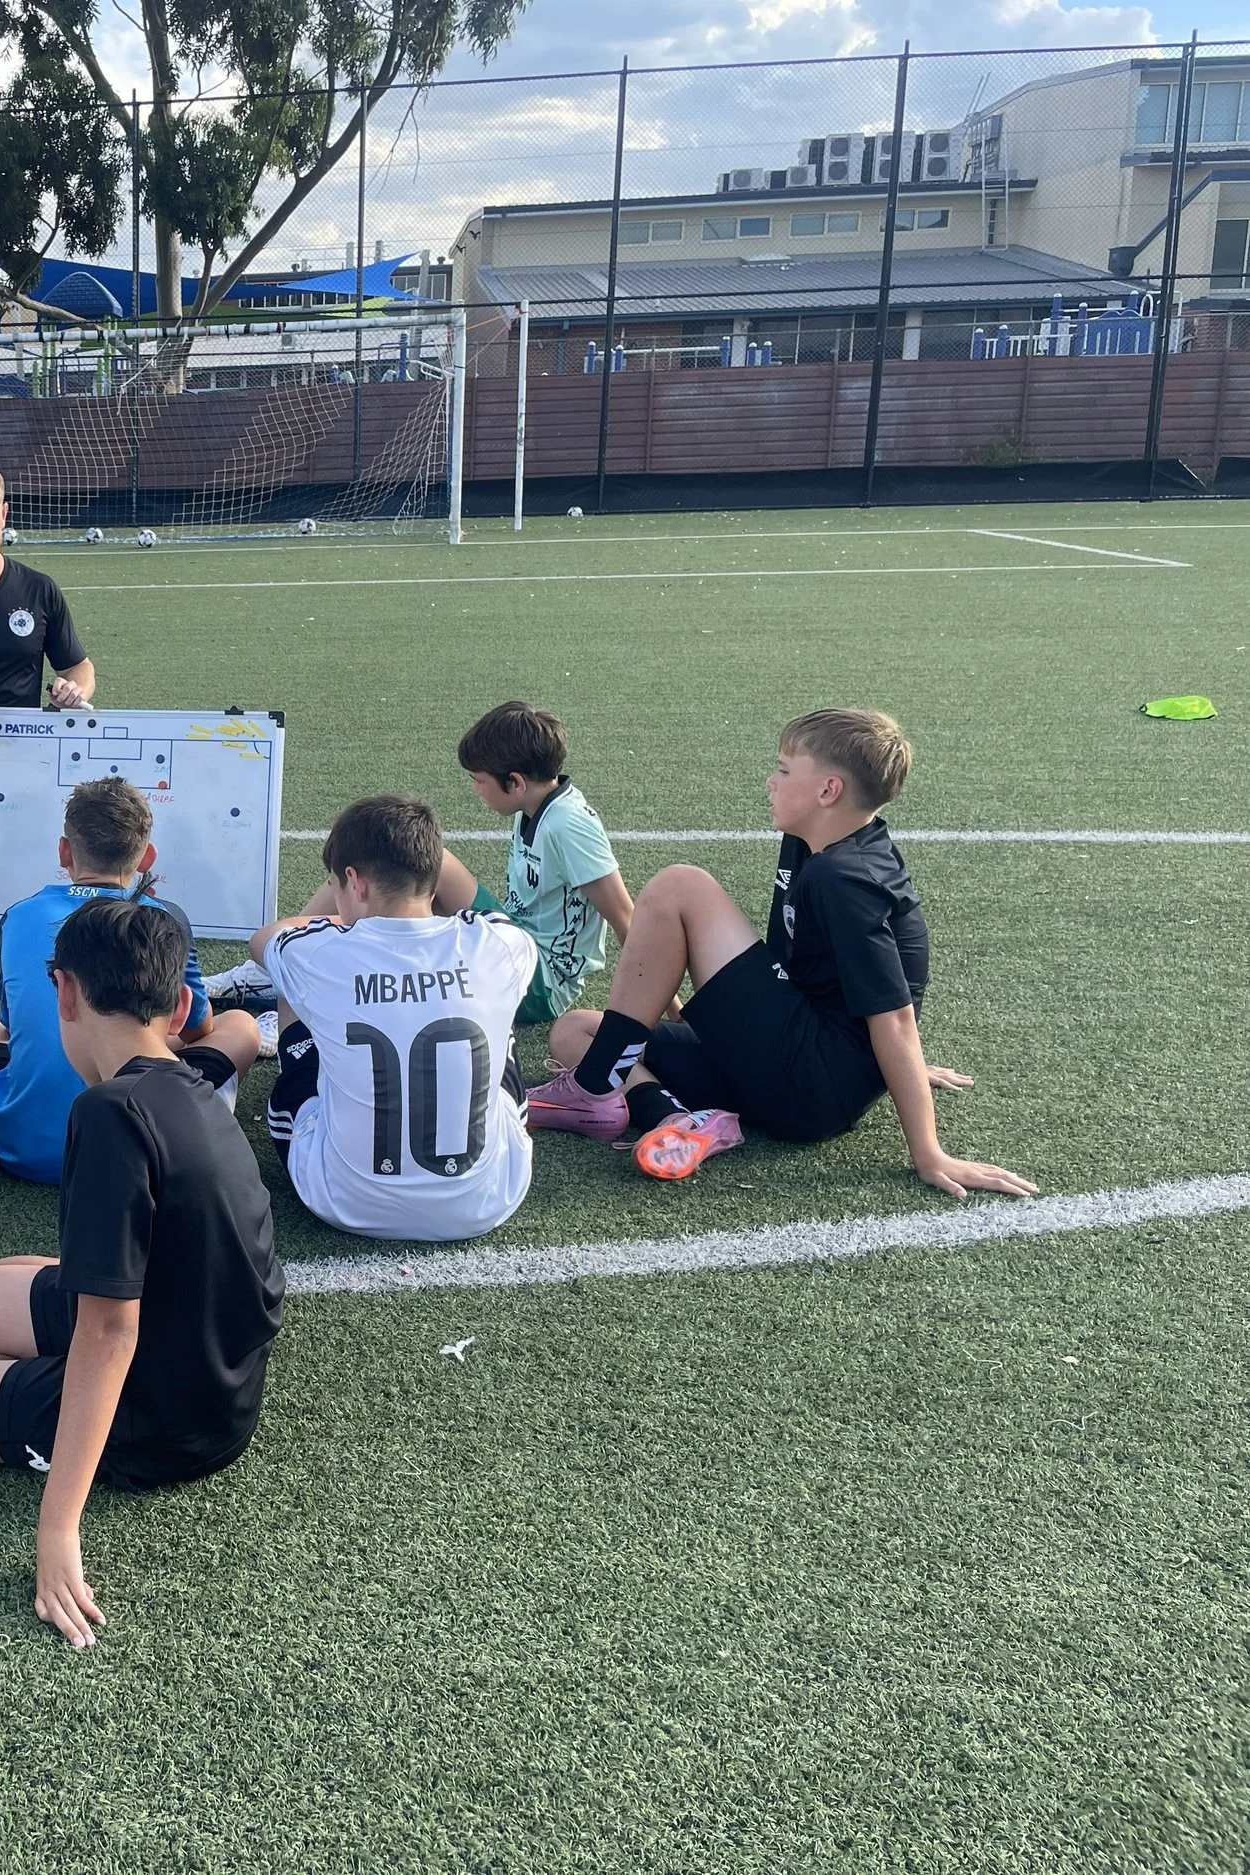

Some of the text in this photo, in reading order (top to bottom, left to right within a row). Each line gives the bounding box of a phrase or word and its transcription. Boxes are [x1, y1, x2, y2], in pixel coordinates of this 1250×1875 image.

[4, 723, 55, 735] PATRICK
[67, 885, 99, 898] SSCN
[354, 959, 474, 1006] MBAPPÉ
[345, 1016, 491, 1178] 10
